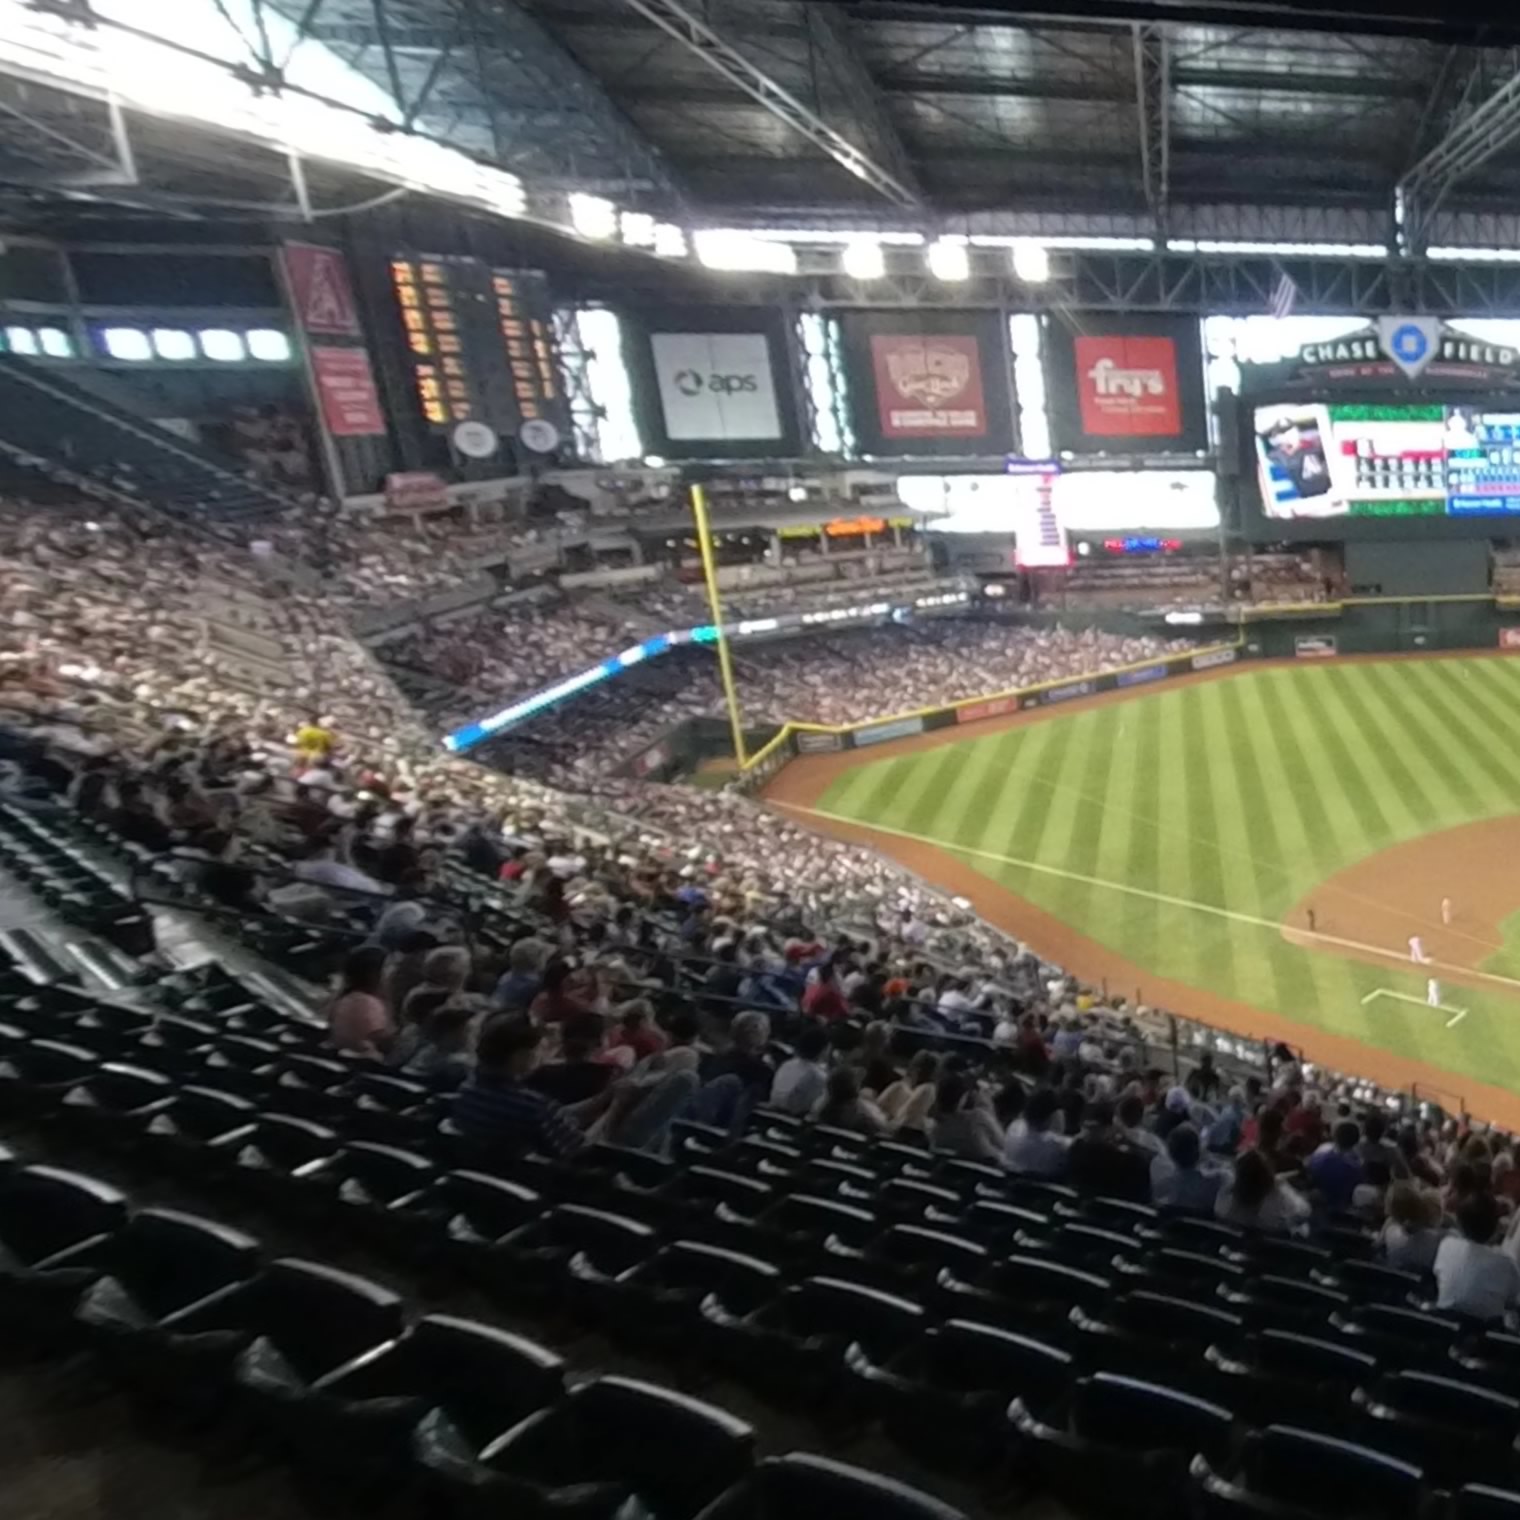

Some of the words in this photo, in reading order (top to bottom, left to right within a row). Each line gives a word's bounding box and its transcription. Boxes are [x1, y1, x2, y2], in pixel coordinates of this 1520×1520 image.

[1303, 340, 1377, 364] CHASE
[1444, 341, 1513, 365] FIELD
[707, 373, 758, 397] aps
[1087, 357, 1165, 397] fry's
